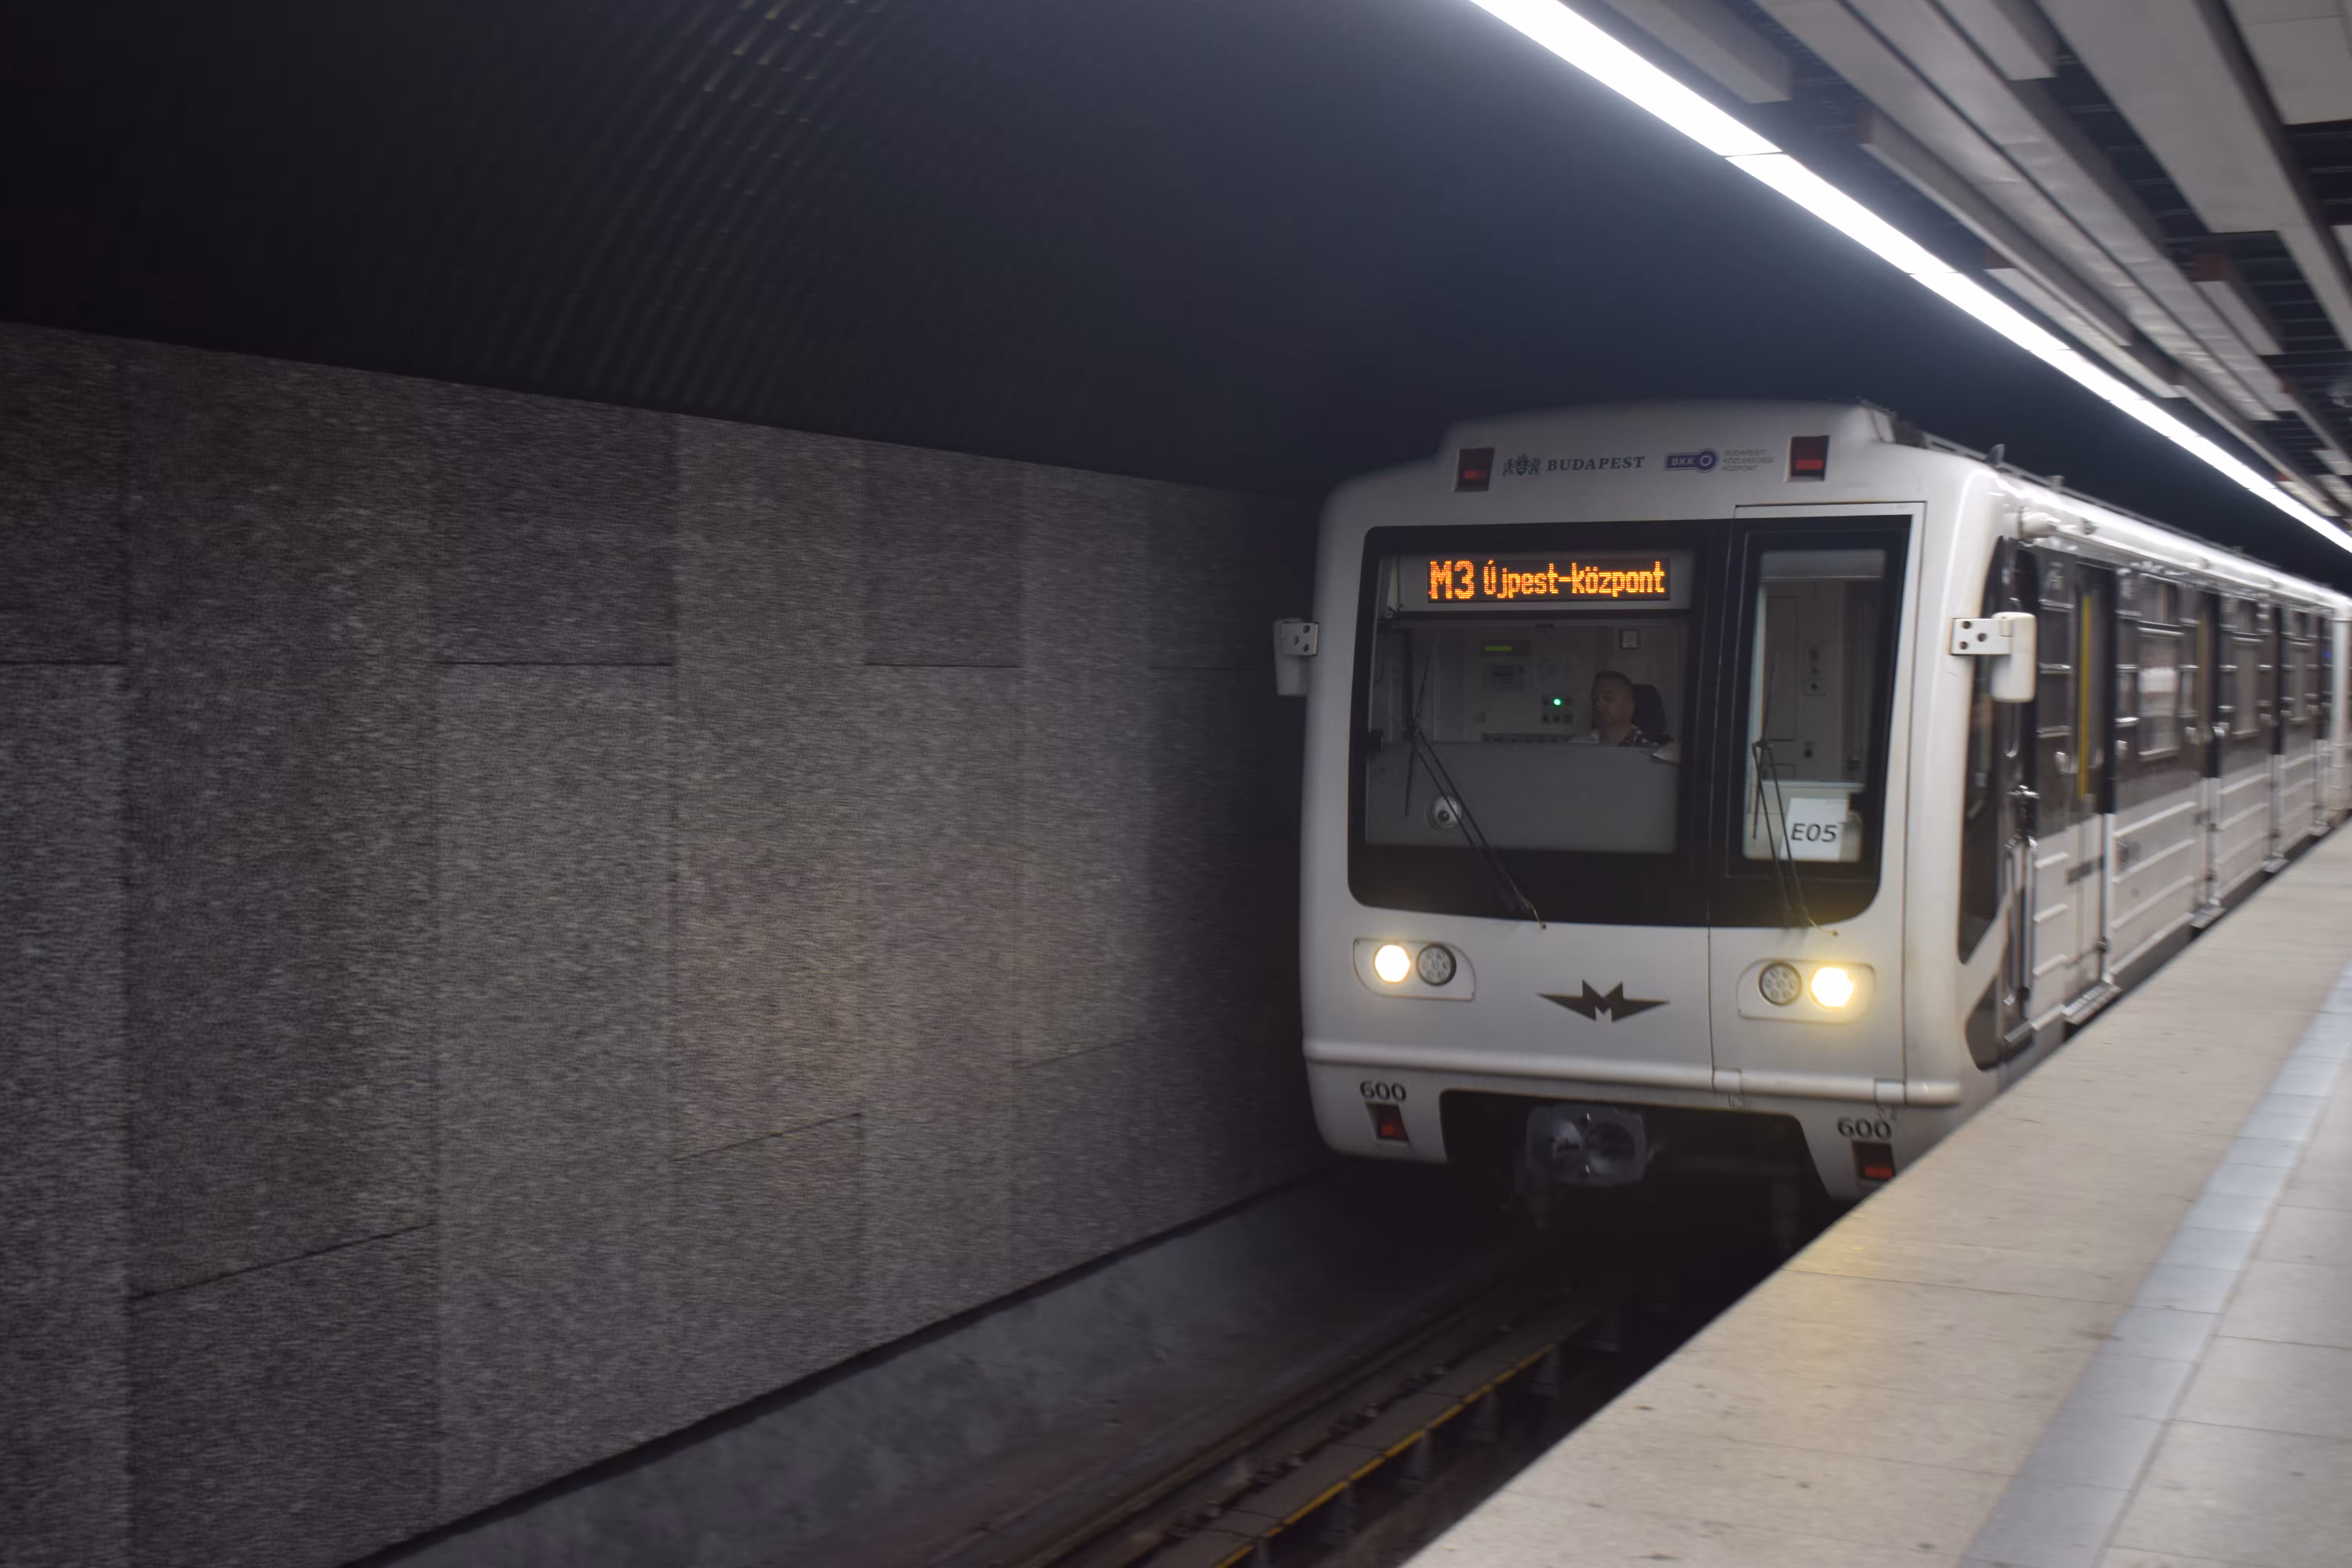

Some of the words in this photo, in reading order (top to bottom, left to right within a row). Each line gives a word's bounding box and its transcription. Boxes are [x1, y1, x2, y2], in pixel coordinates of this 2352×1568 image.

[1547, 456, 1645, 471] BUDAPEST
[1671, 457, 1694, 466] BKK
[1430, 561, 1474, 599] M3
[1483, 560, 1665, 598] Újpest-központ
[1790, 822, 1838, 842] E05
[1359, 1081, 1407, 1102] 600
[1837, 1116, 1892, 1141] 600
